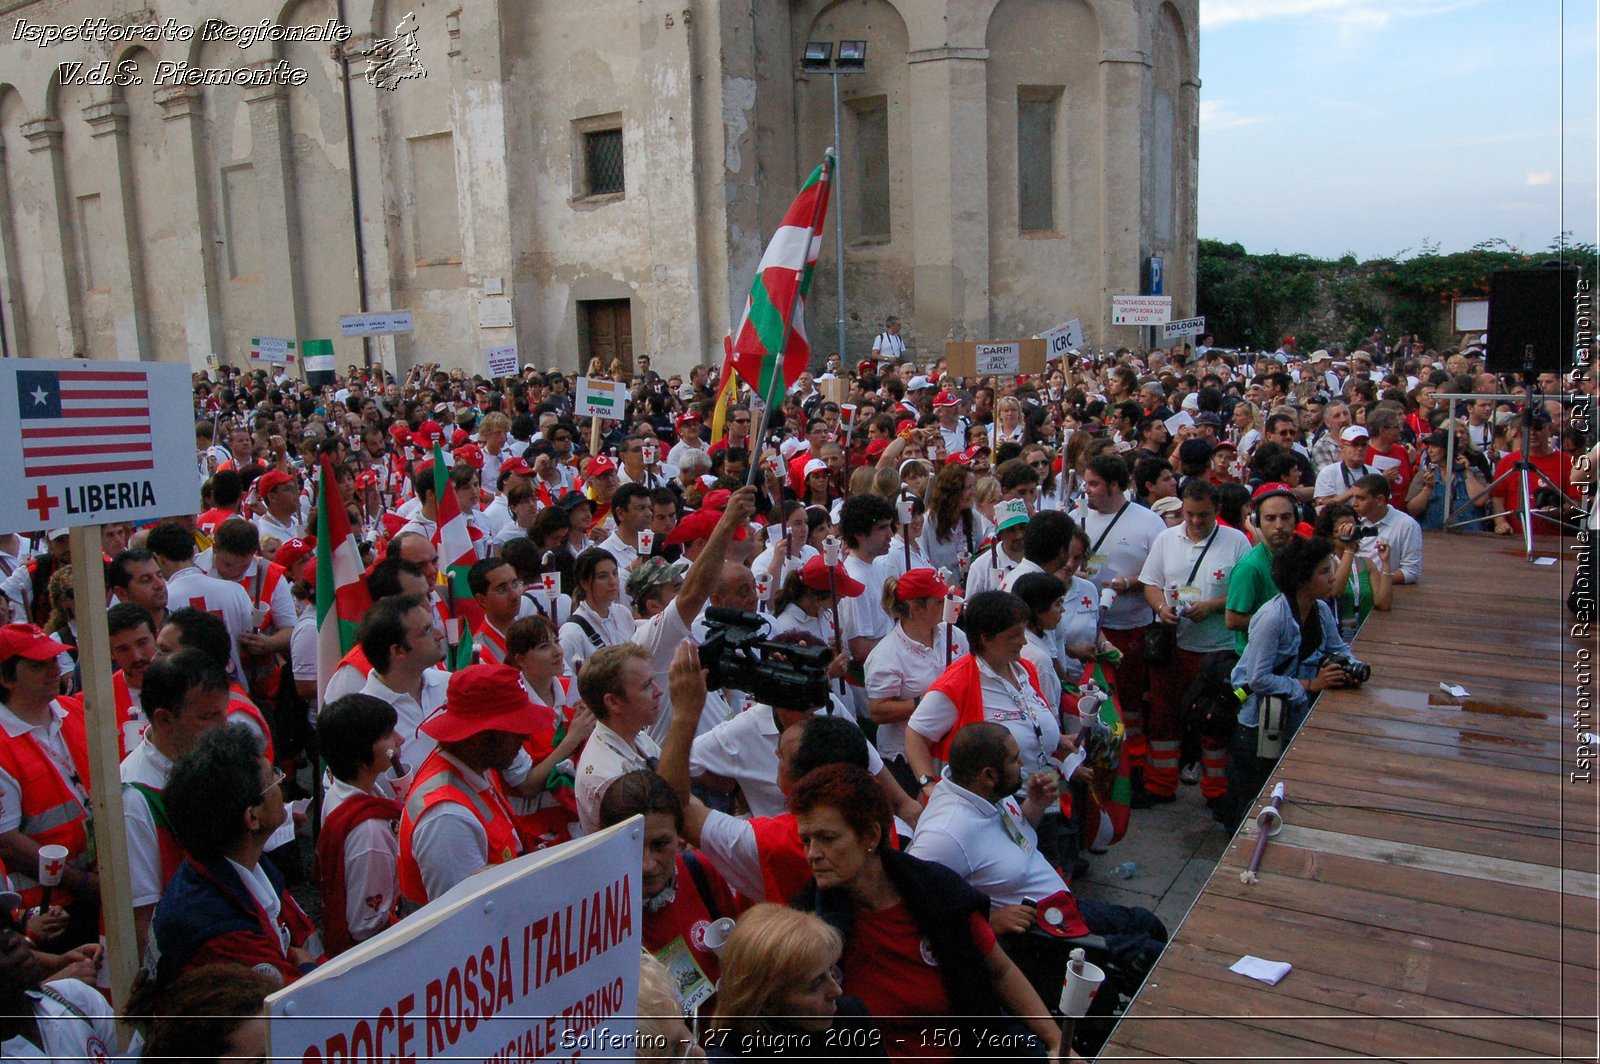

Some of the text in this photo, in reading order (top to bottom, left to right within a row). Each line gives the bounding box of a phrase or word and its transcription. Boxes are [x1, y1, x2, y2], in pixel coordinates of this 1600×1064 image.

[1165, 320, 1204, 332] BOLOGNA
[983, 346, 1012, 354] CARPI
[1052, 333, 1073, 353] ICRC
[596, 407, 611, 416] INDIA
[65, 480, 157, 515] LIBERIA
[426, 936, 514, 1059] ROSSA
[522, 873, 632, 997] ITALIANA
[562, 976, 624, 1043] TORINO
